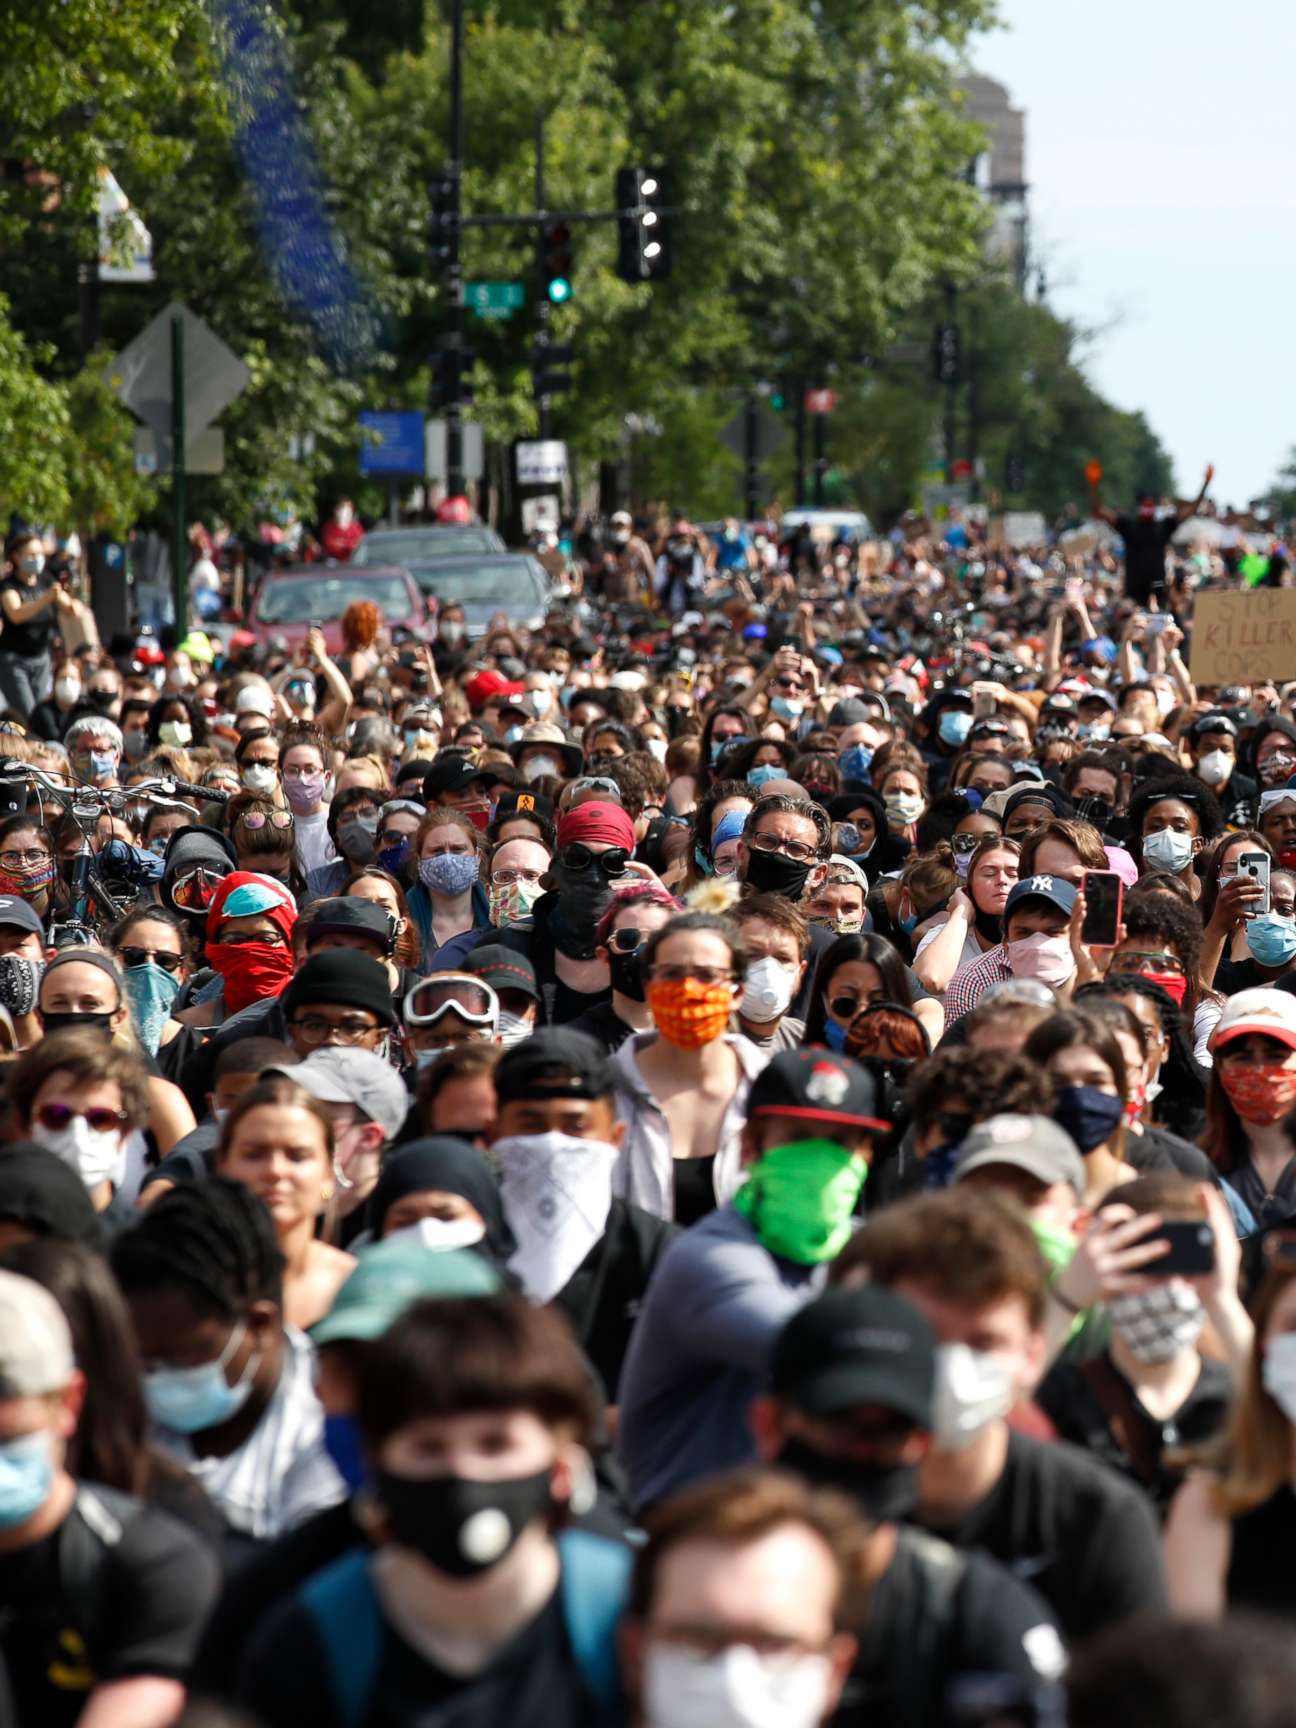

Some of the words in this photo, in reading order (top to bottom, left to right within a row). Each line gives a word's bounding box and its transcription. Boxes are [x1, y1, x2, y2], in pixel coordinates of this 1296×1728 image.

[1218, 588, 1281, 622] STOP
[1204, 619, 1293, 650] KILLER
[1213, 649, 1273, 679] COPS
[1031, 875, 1053, 891] NY
